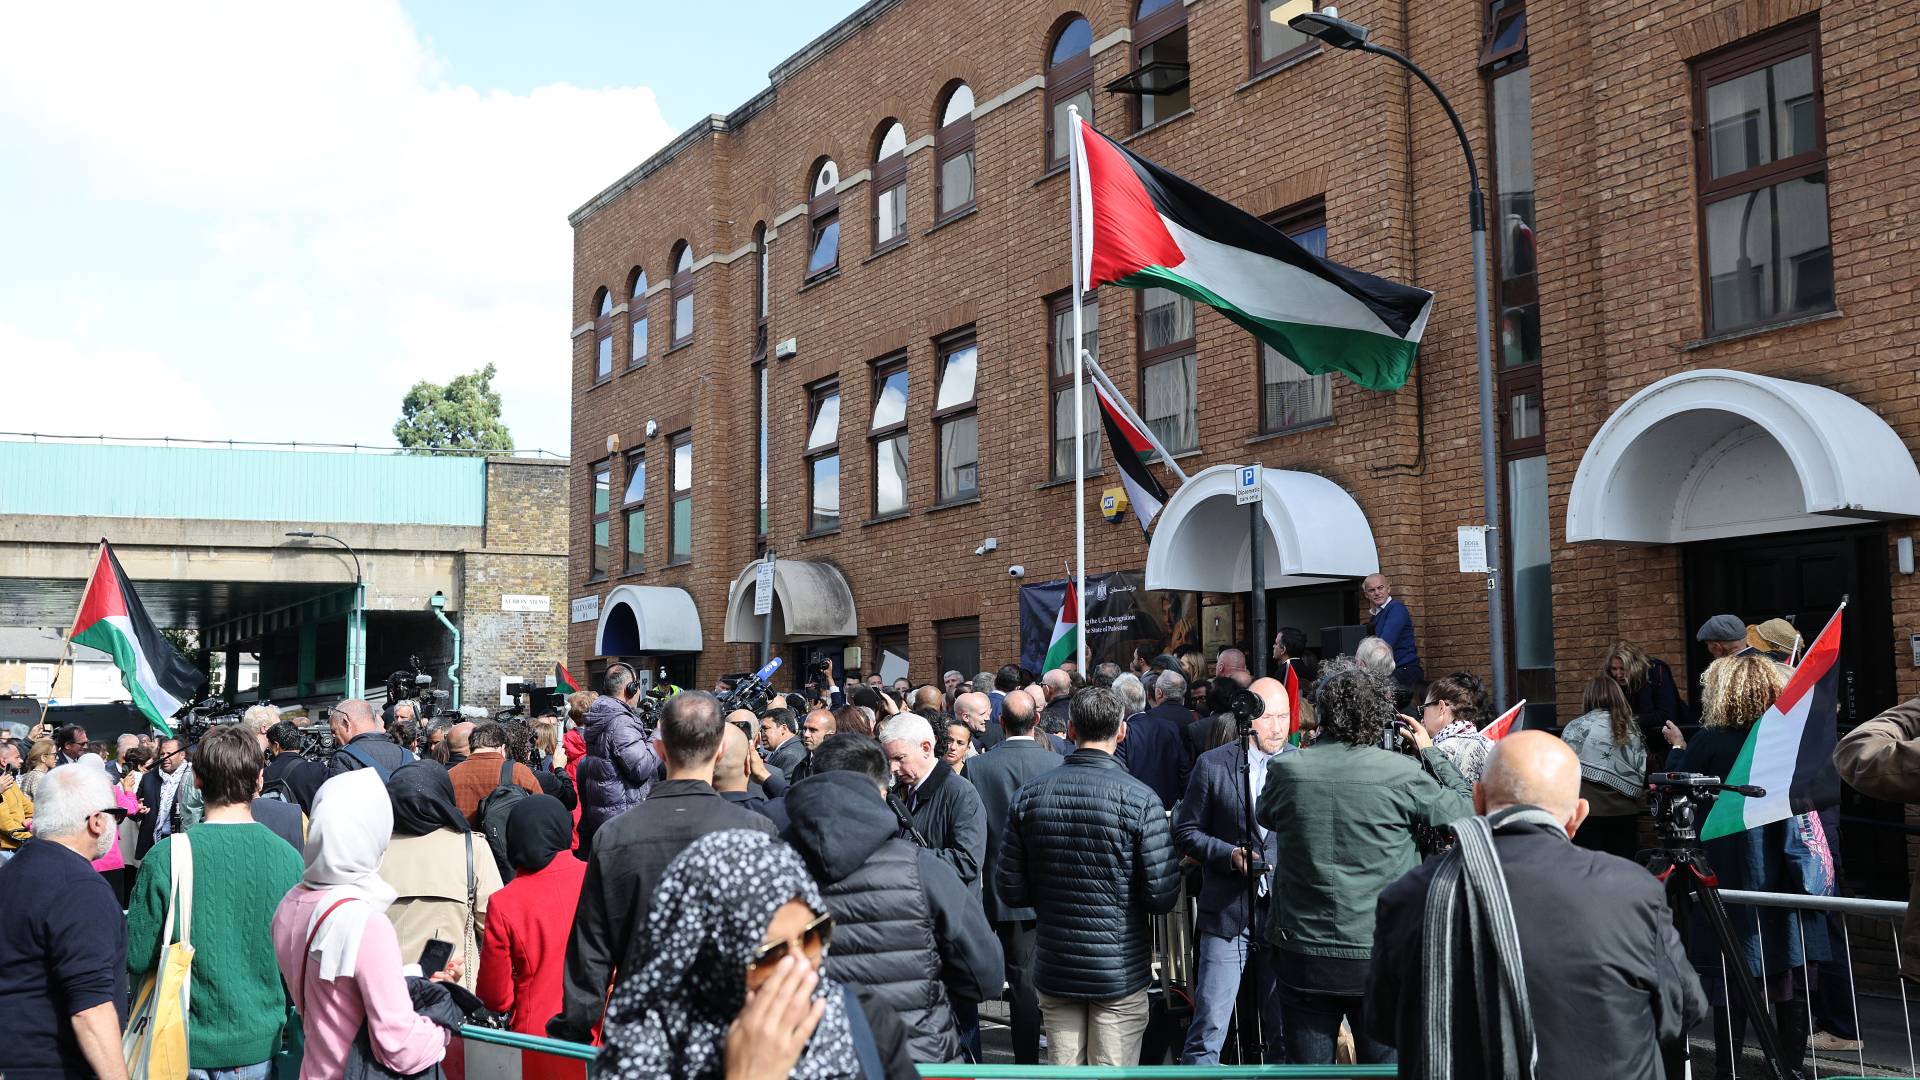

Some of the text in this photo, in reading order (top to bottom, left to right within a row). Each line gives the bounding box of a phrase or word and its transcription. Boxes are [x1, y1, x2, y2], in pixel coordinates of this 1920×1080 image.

[1246, 470, 1252, 484] P
[1489, 580, 1493, 588] 4
[1109, 614, 1136, 623] Recognition
